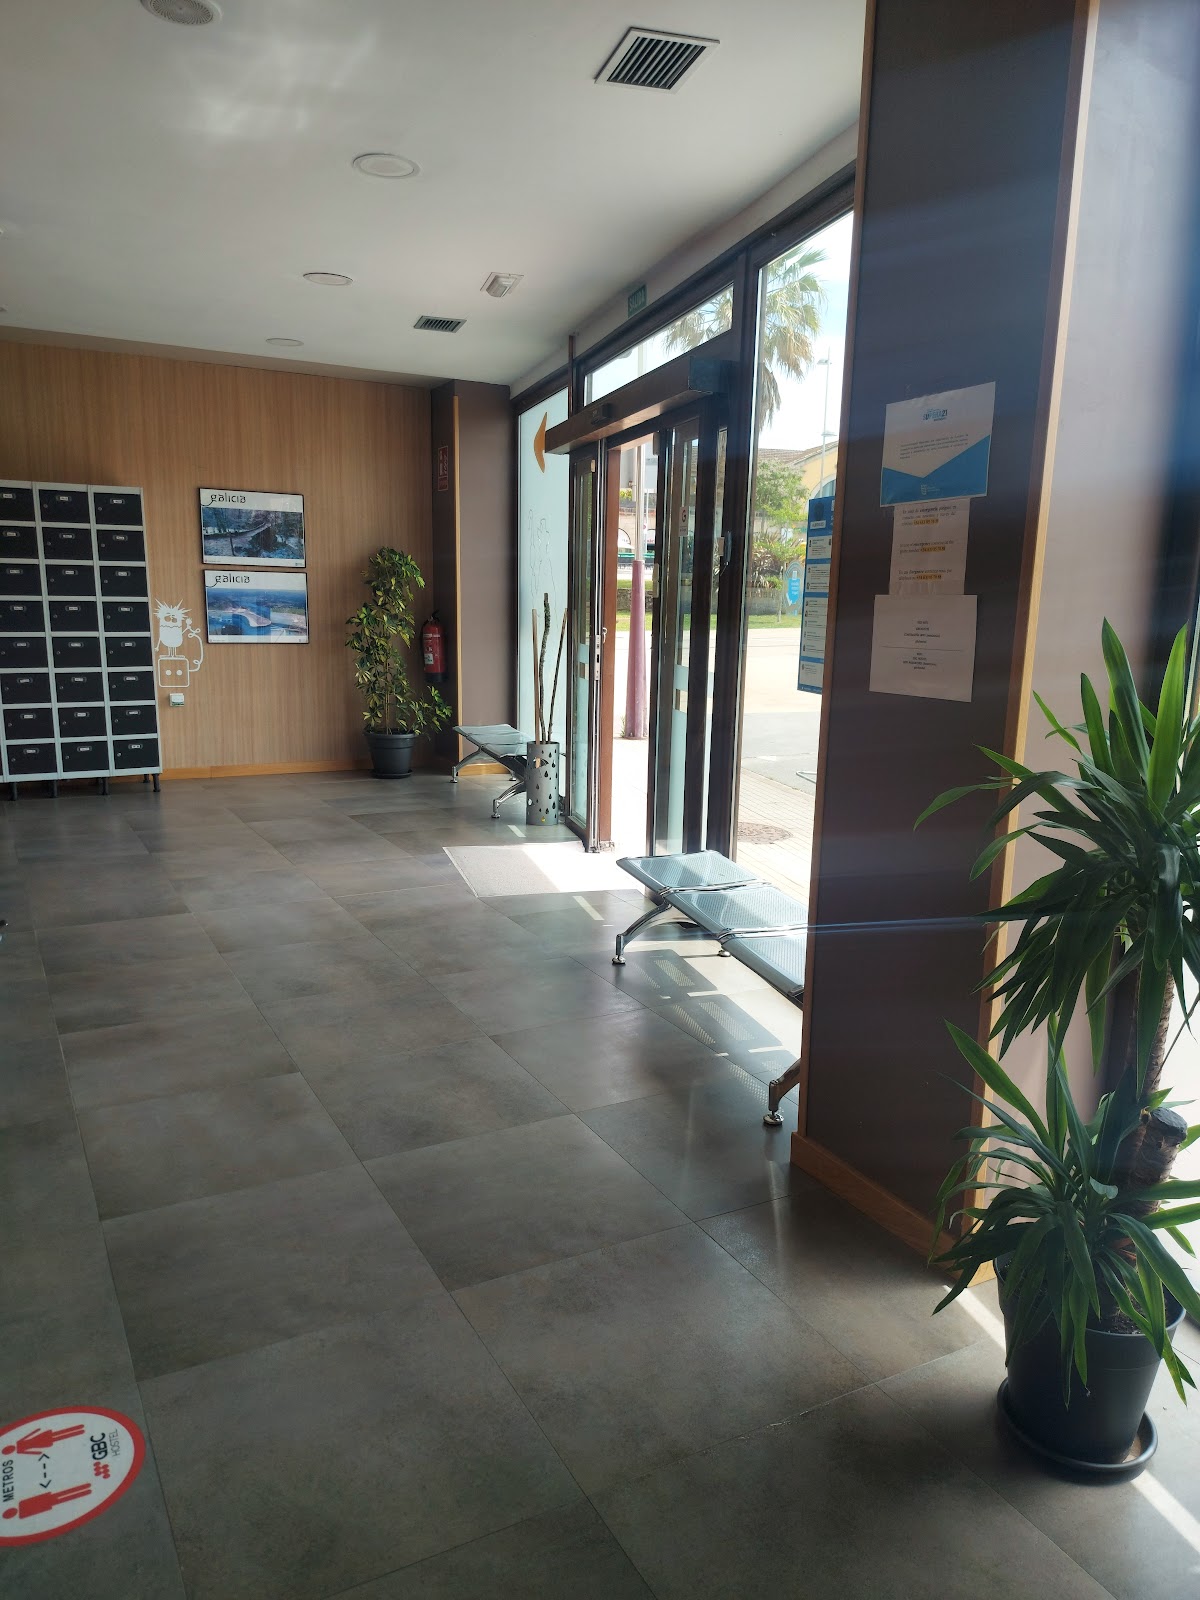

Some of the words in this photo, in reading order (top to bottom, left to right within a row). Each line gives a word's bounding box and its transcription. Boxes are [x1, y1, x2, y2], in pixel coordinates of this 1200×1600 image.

[629, 288, 645, 313] SALIDA
[207, 492, 246, 504] galicia
[212, 573, 250, 585] galicia
[90, 1432, 108, 1461] GBC
[108, 1428, 121, 1457] HOSTEL
[2, 1459, 14, 1502] METROS
